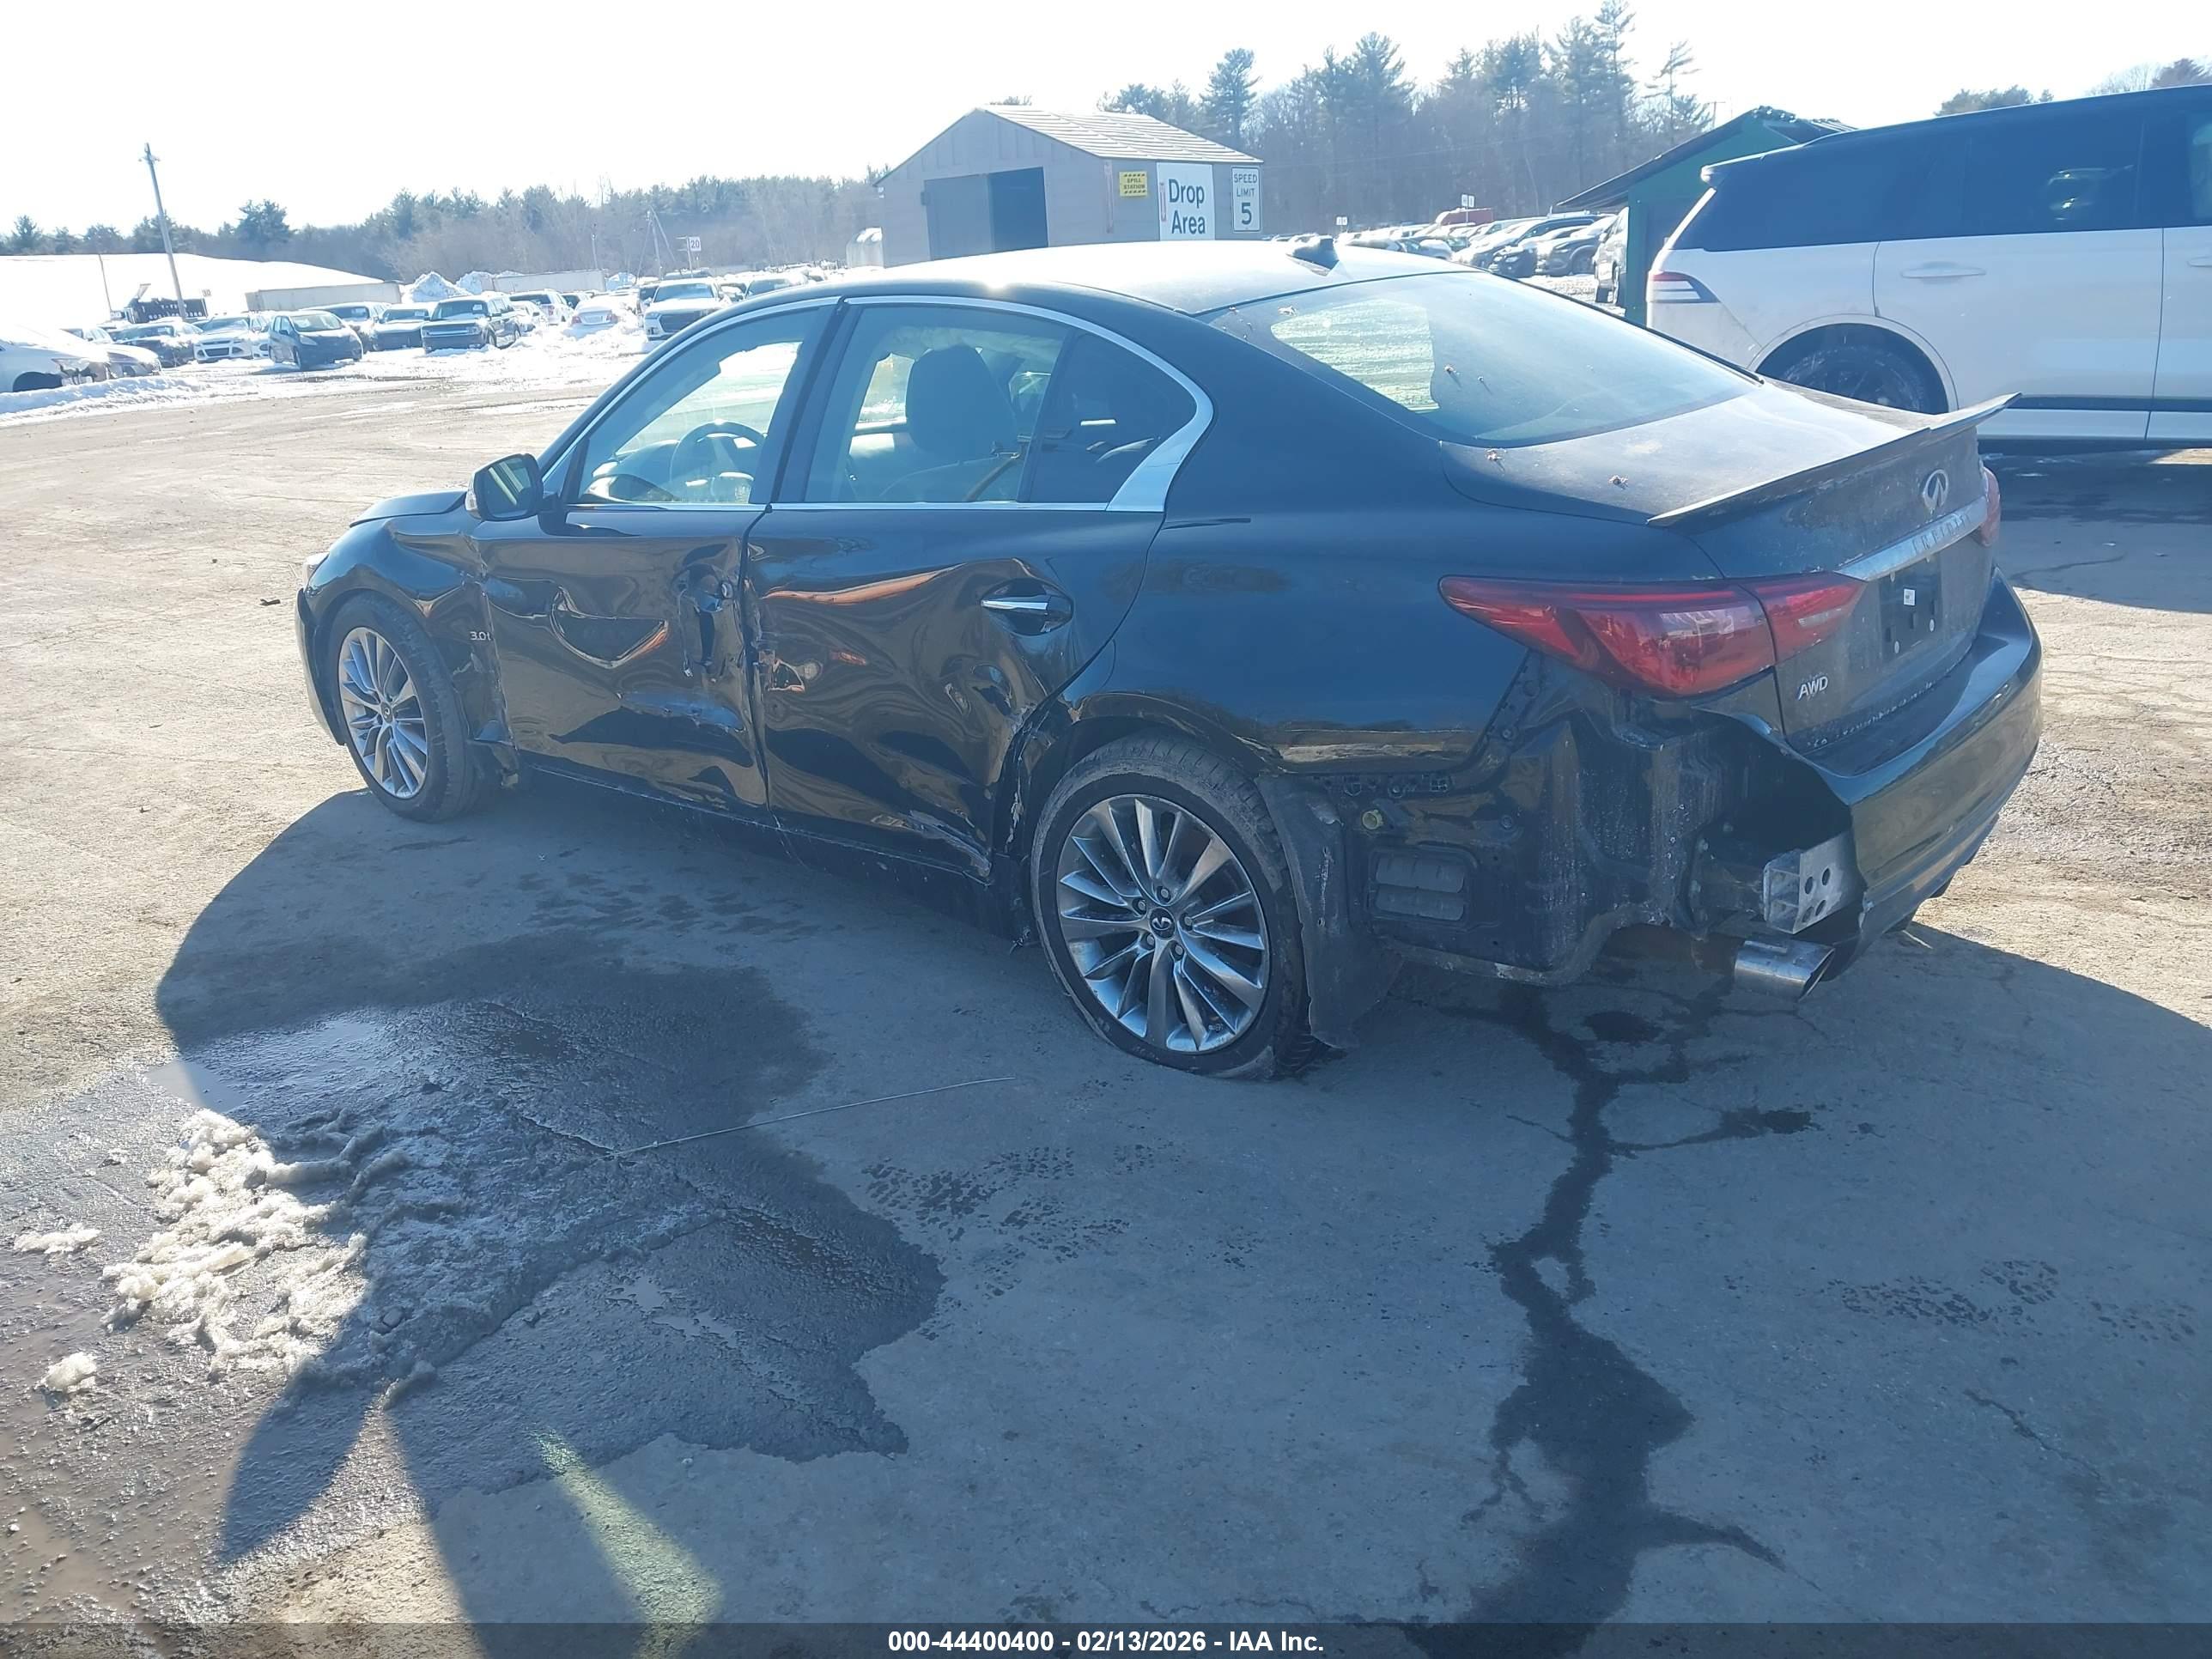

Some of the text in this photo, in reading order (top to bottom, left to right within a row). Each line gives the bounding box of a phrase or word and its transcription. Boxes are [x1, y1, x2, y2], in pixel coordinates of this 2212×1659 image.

[1234, 173, 1258, 184] SPEED
[1169, 179, 1205, 209] Drop
[1237, 188, 1255, 198] LIMIT
[1171, 210, 1206, 234] Area
[1241, 202, 1252, 225] 5
[690, 240, 700, 248] 20
[1798, 676, 1828, 700] AWD
